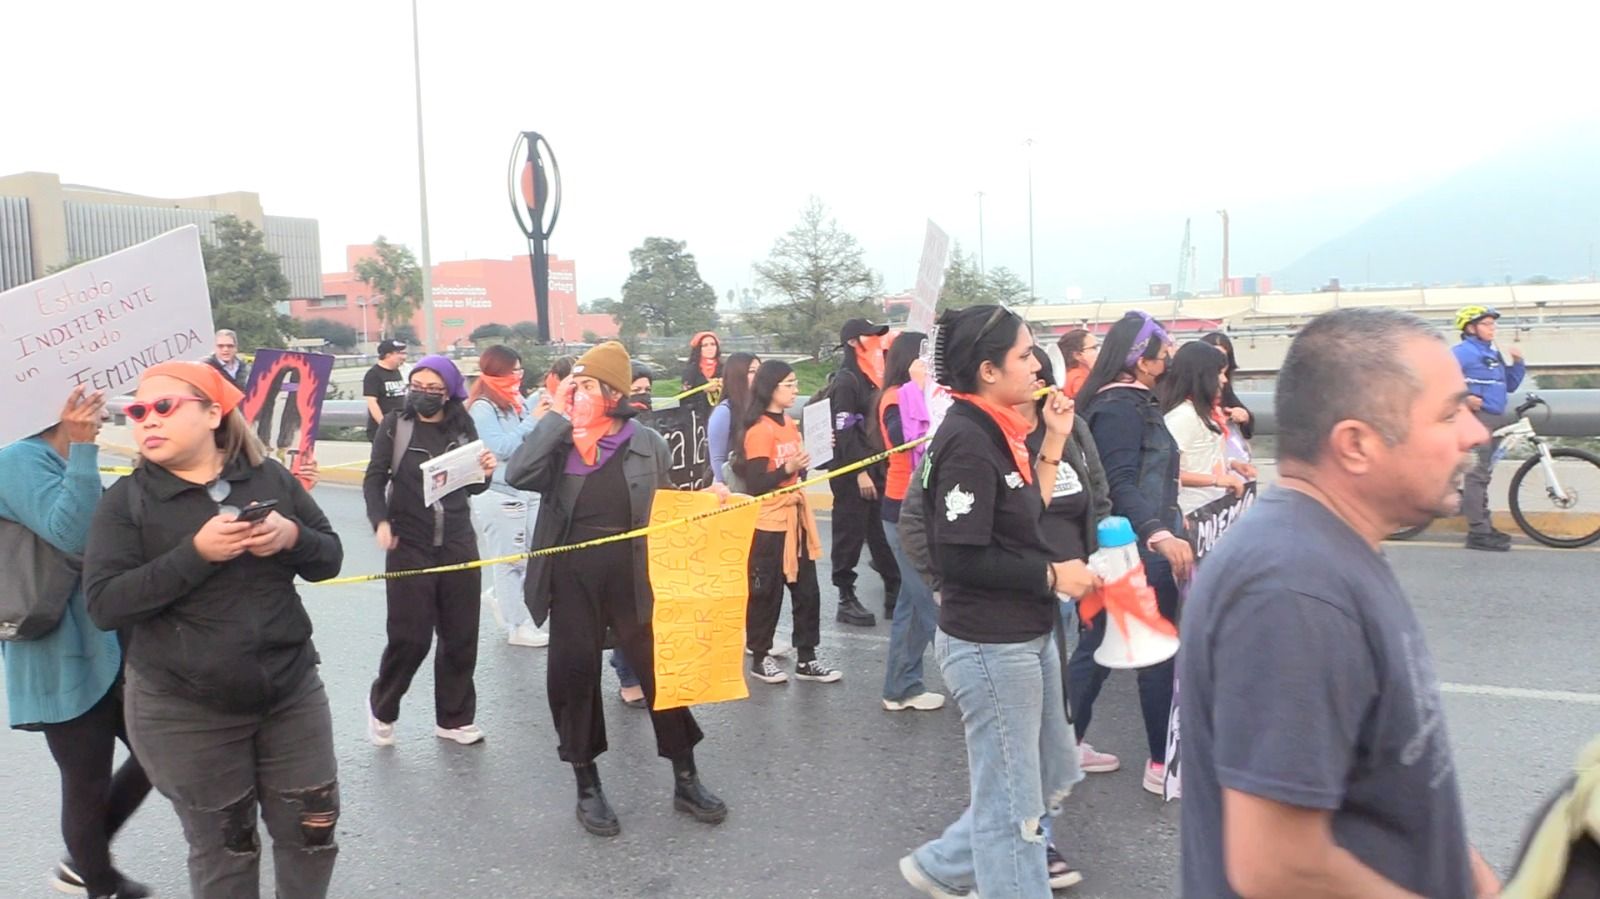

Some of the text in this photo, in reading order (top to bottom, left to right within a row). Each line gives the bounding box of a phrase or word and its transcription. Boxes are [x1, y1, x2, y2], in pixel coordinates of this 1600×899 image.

[34, 271, 113, 317] Estado
[432, 283, 487, 295] oleccionismo
[15, 328, 122, 384] un Estado
